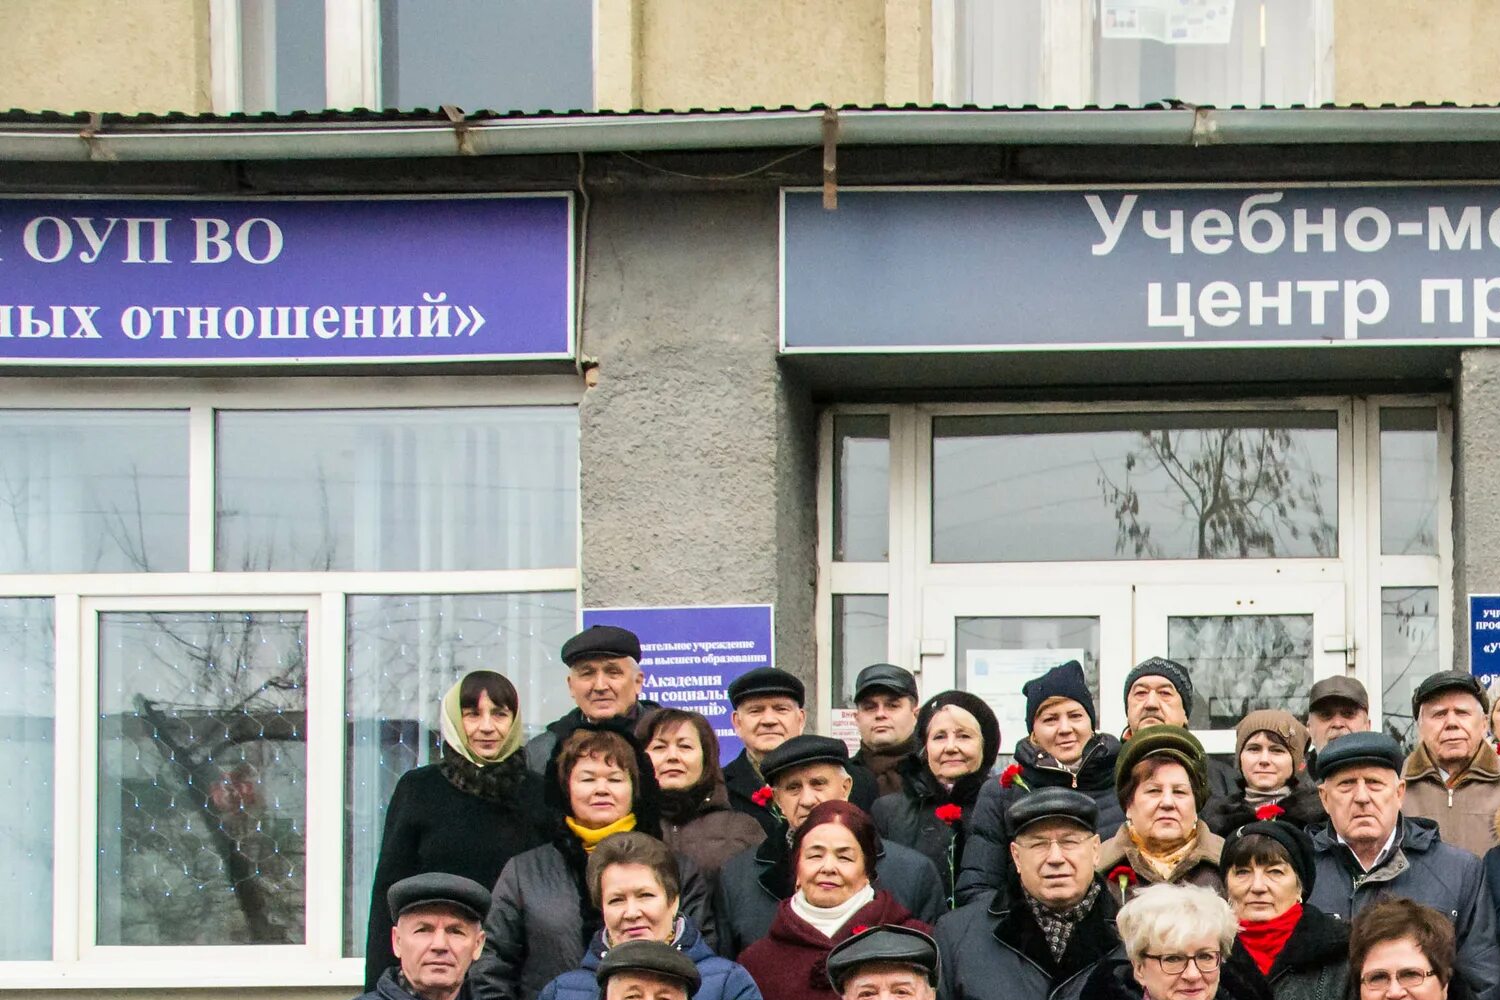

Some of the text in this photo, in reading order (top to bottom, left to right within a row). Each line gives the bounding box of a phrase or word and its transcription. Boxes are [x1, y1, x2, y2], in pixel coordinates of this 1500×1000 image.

[23, 215, 284, 265] ОУП ВО
[121, 292, 486, 340] отношений»
[1147, 271, 1390, 339] центр
[640, 640, 755, 652] вательное учреждение
[702, 653, 767, 666] образования
[661, 689, 729, 702] социаль
